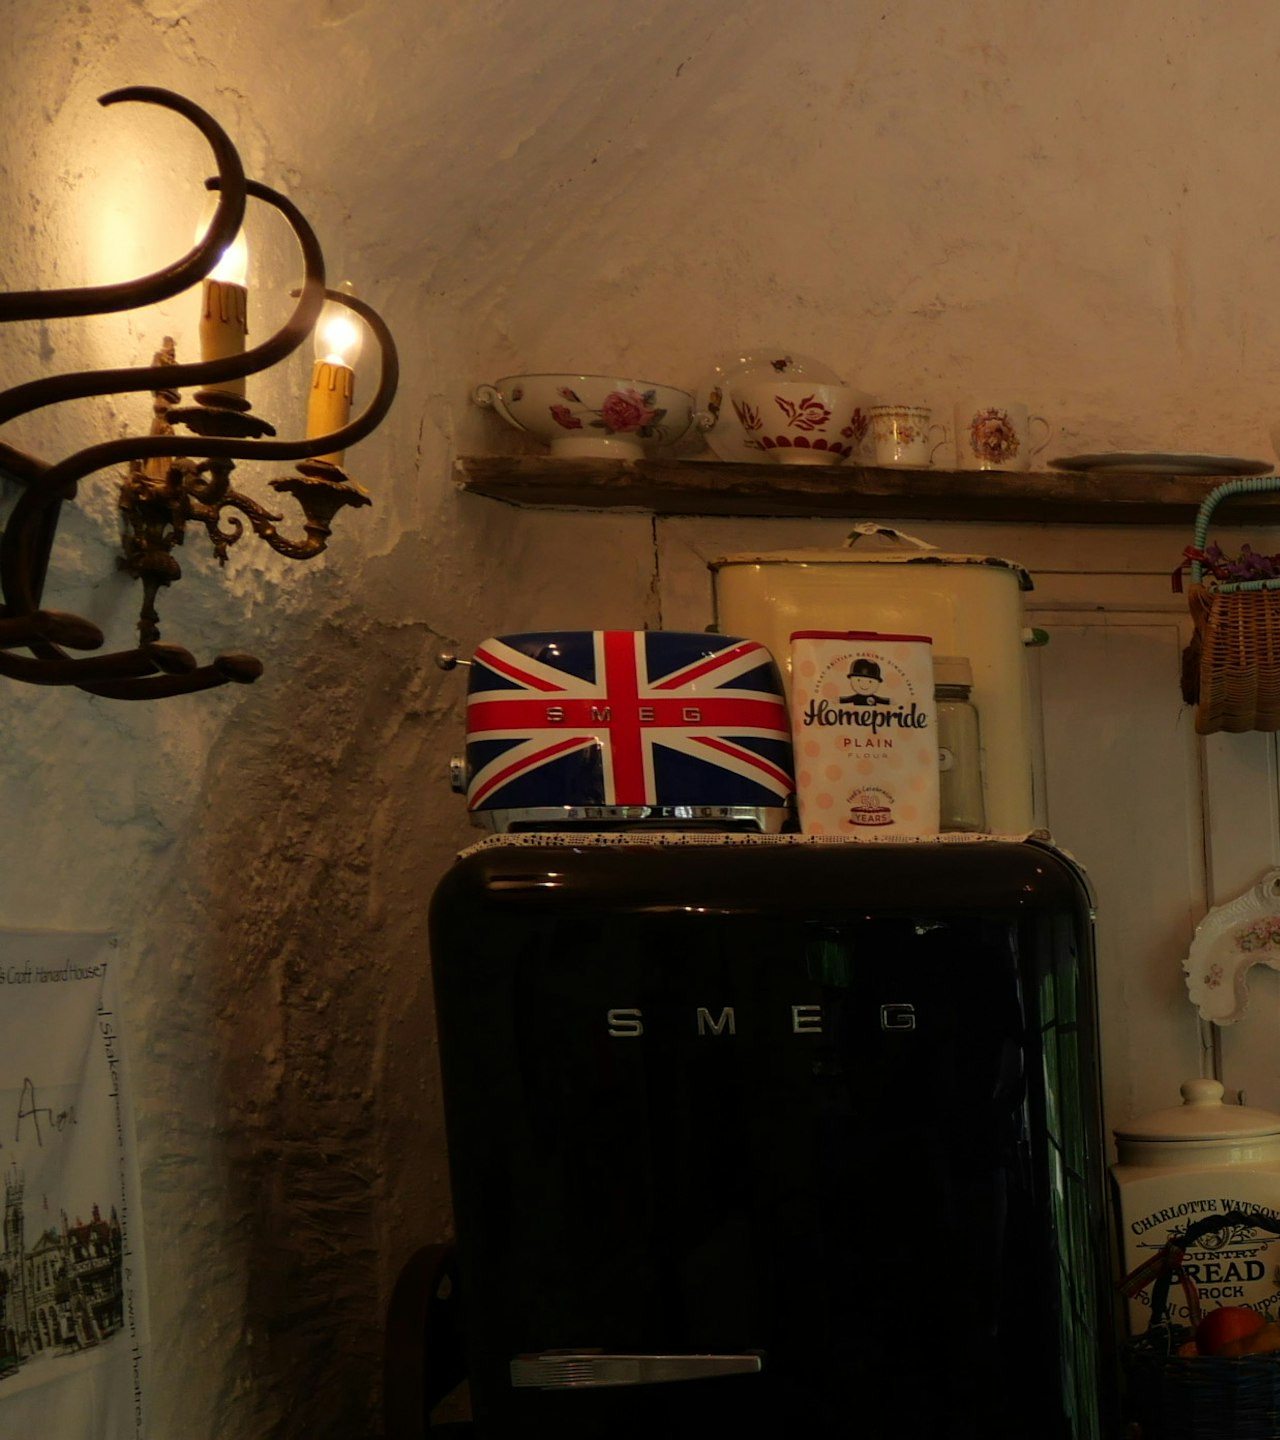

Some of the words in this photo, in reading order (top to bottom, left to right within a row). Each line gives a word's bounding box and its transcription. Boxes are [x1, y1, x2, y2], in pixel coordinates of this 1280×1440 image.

[546, 706, 701, 722] SMEG
[803, 699, 927, 735] Homepride
[843, 738, 893, 748] PLAIN
[855, 814, 887, 822] YEARS
[607, 1003, 916, 1037] SMEG
[1130, 1199, 1217, 1236] CHARLOTTE
[1182, 1248, 1260, 1262] OUNTRY
[1169, 1260, 1265, 1286] BREAD
[1134, 1288, 1151, 1307] Fo
[1199, 1285, 1244, 1299] ROCK
